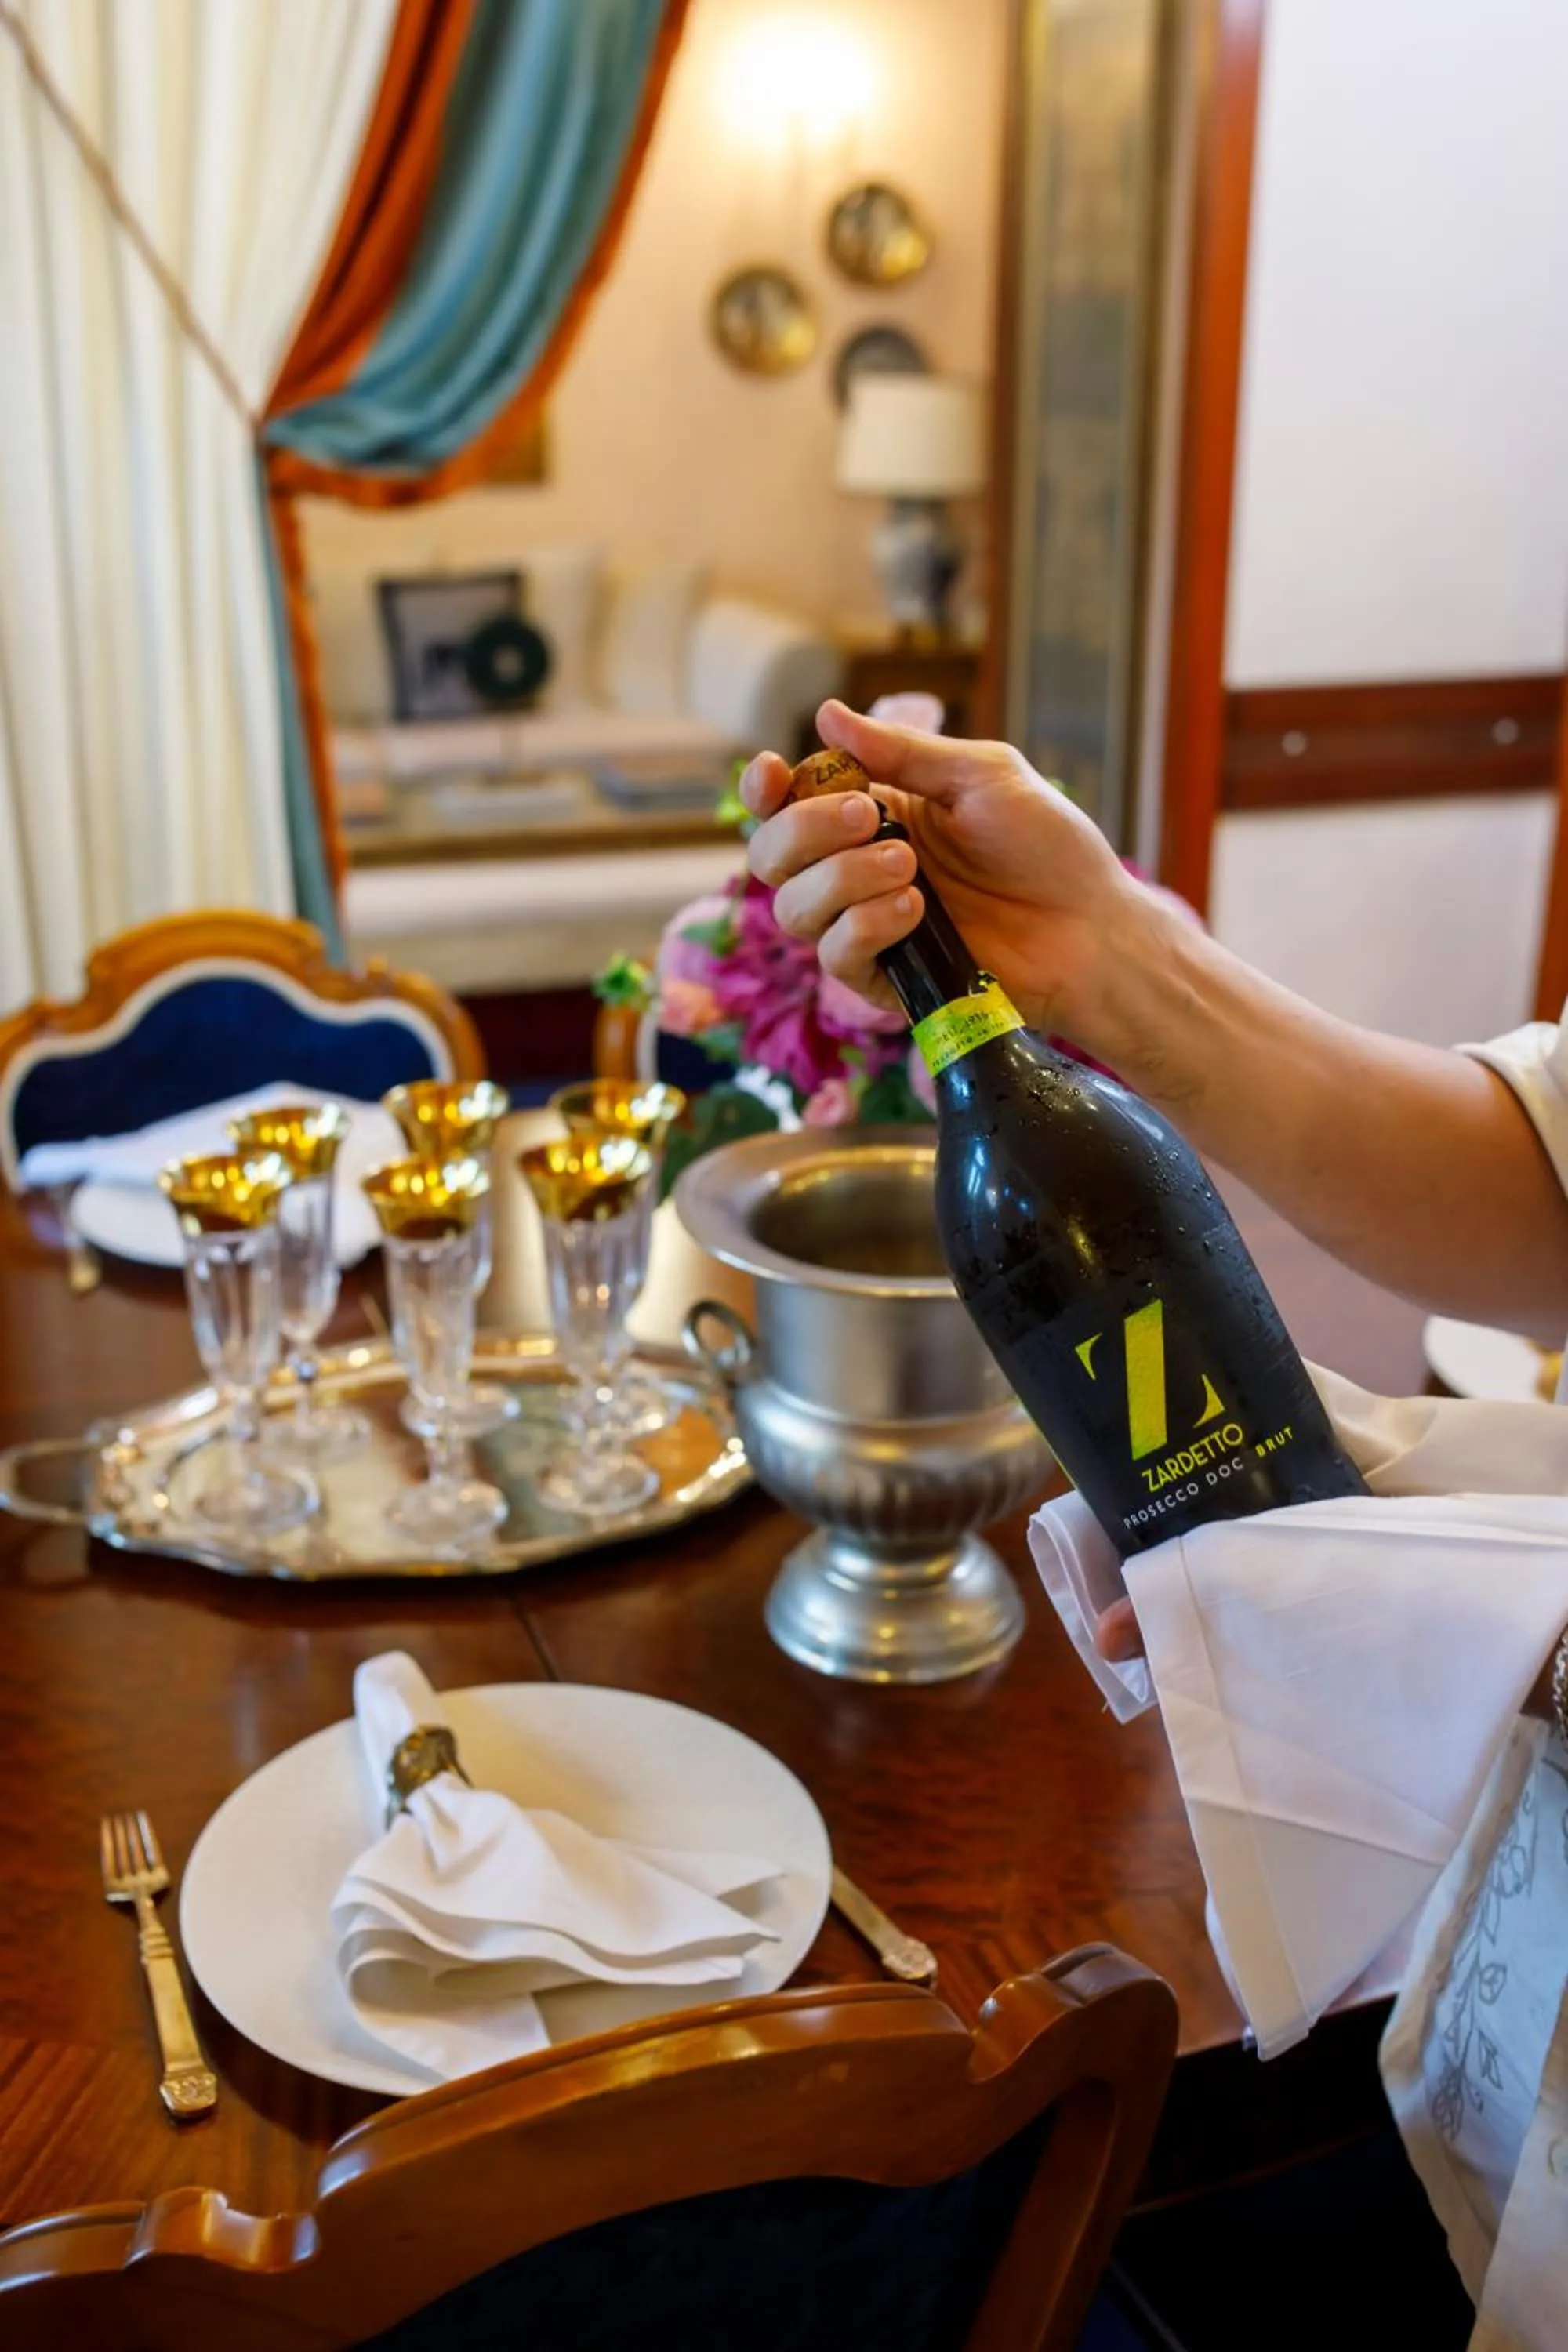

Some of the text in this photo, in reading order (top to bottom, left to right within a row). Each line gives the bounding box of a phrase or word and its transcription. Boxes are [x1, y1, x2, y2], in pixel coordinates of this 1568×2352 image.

[1123, 1426, 1294, 1529] PROSECCO DOC BRUT
[1141, 1423, 1243, 1492] ZARDETTO
